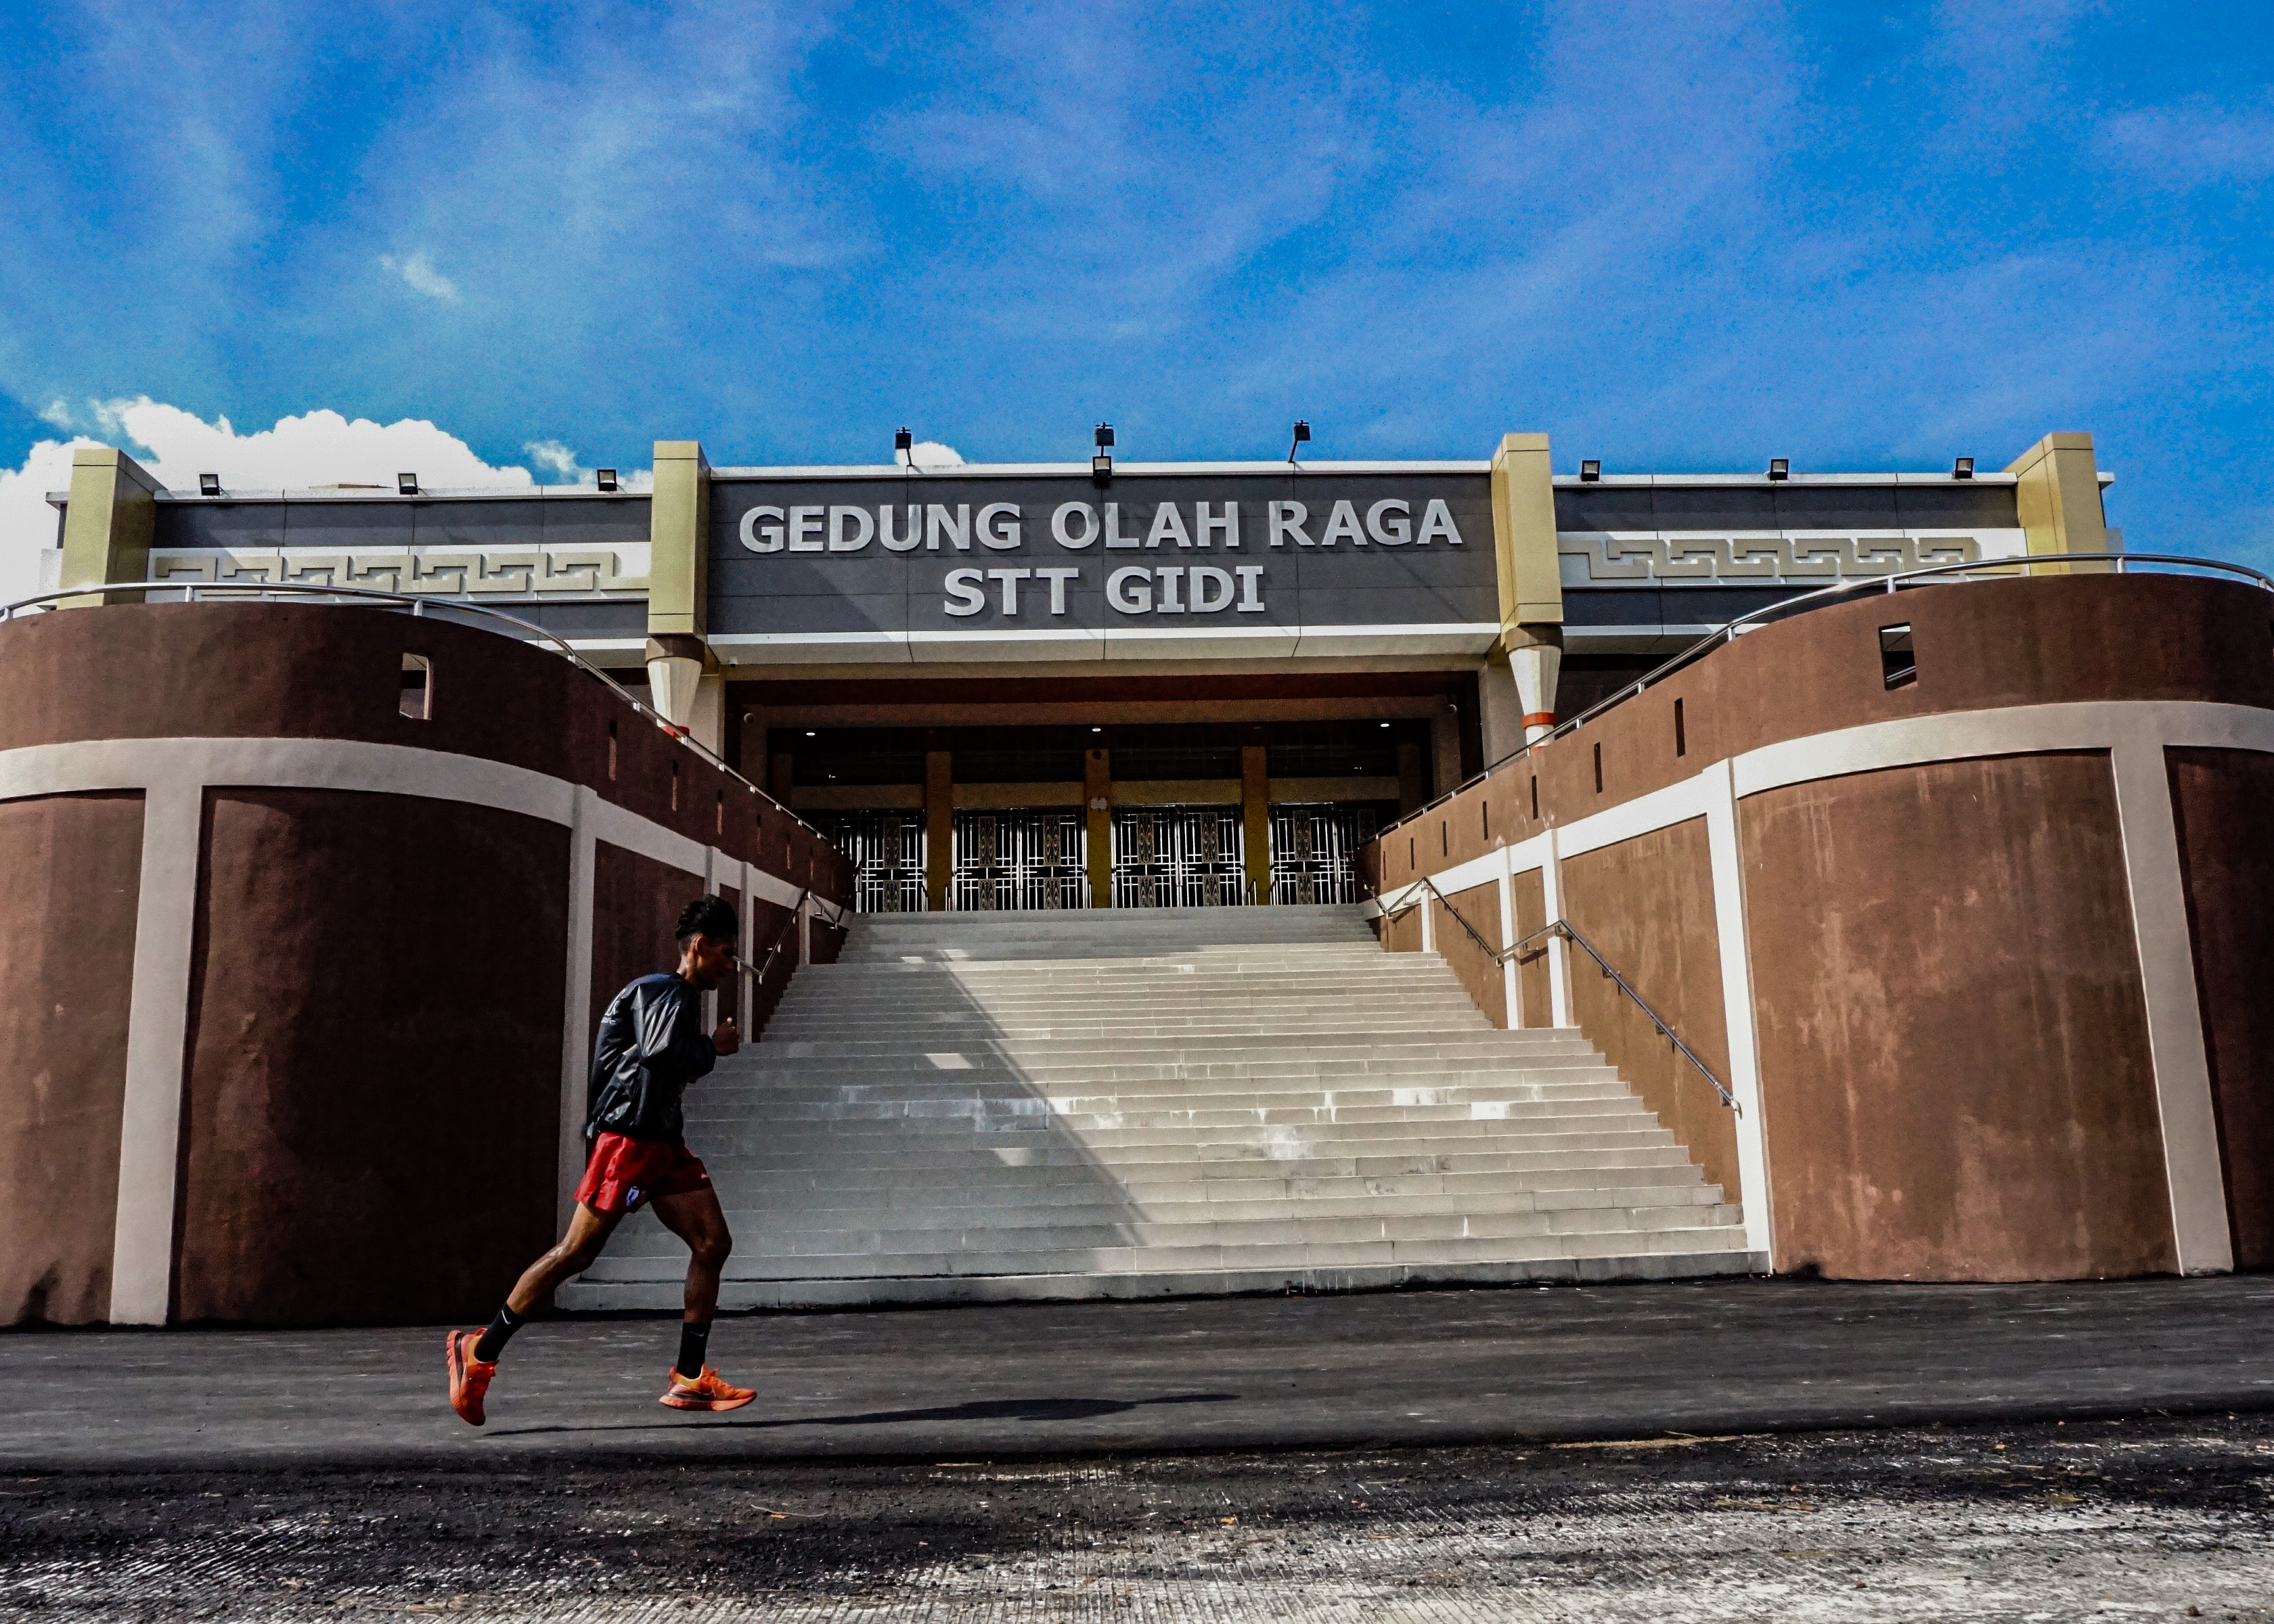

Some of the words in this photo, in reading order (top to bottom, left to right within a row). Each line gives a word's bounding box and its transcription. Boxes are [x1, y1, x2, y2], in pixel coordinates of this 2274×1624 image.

[739, 503, 1021, 553] GEDUNG
[1051, 501, 1239, 549] OLAH
[1268, 499, 1463, 546] RAGA
[943, 567, 1079, 616] STT
[1106, 565, 1265, 614] GIDI
